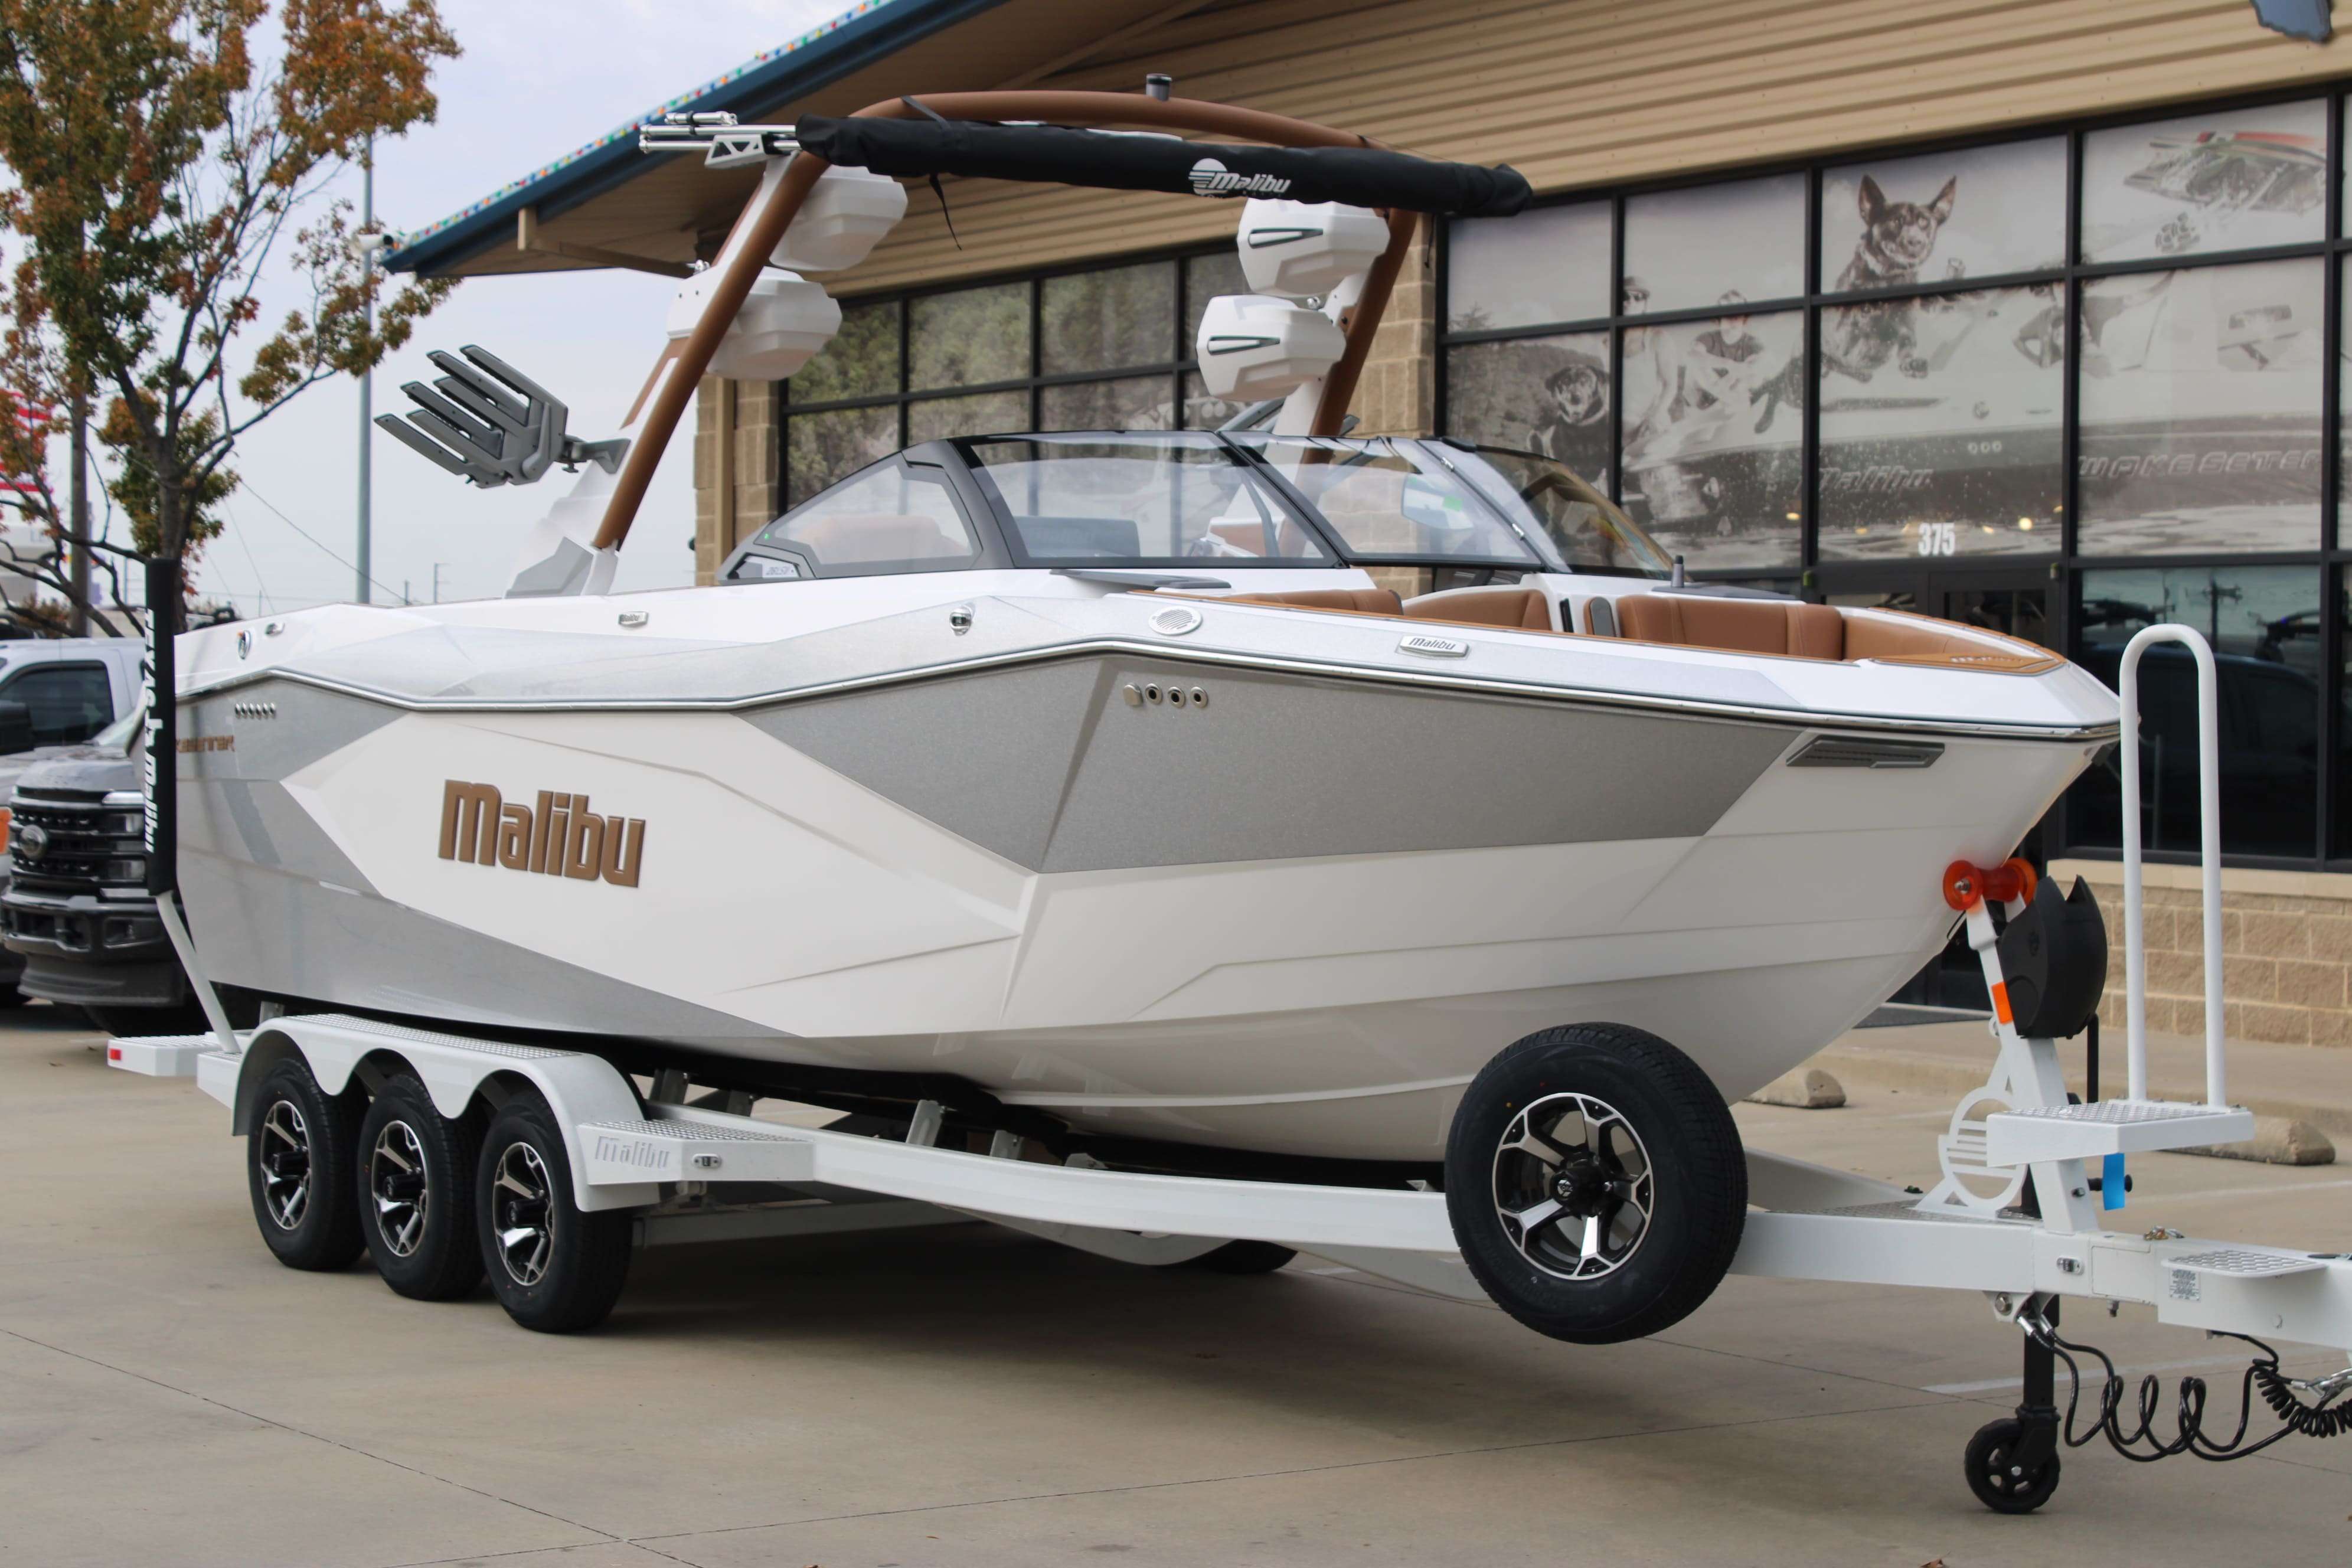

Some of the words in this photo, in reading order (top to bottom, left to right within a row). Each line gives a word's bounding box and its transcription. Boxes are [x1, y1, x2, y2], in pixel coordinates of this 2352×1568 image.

[1208, 172, 1291, 194] Malibu
[1919, 522, 1956, 556] 375
[1409, 638, 1456, 651] Malibu
[438, 779, 646, 888] Malibu
[594, 1135, 671, 1169] Malibu
